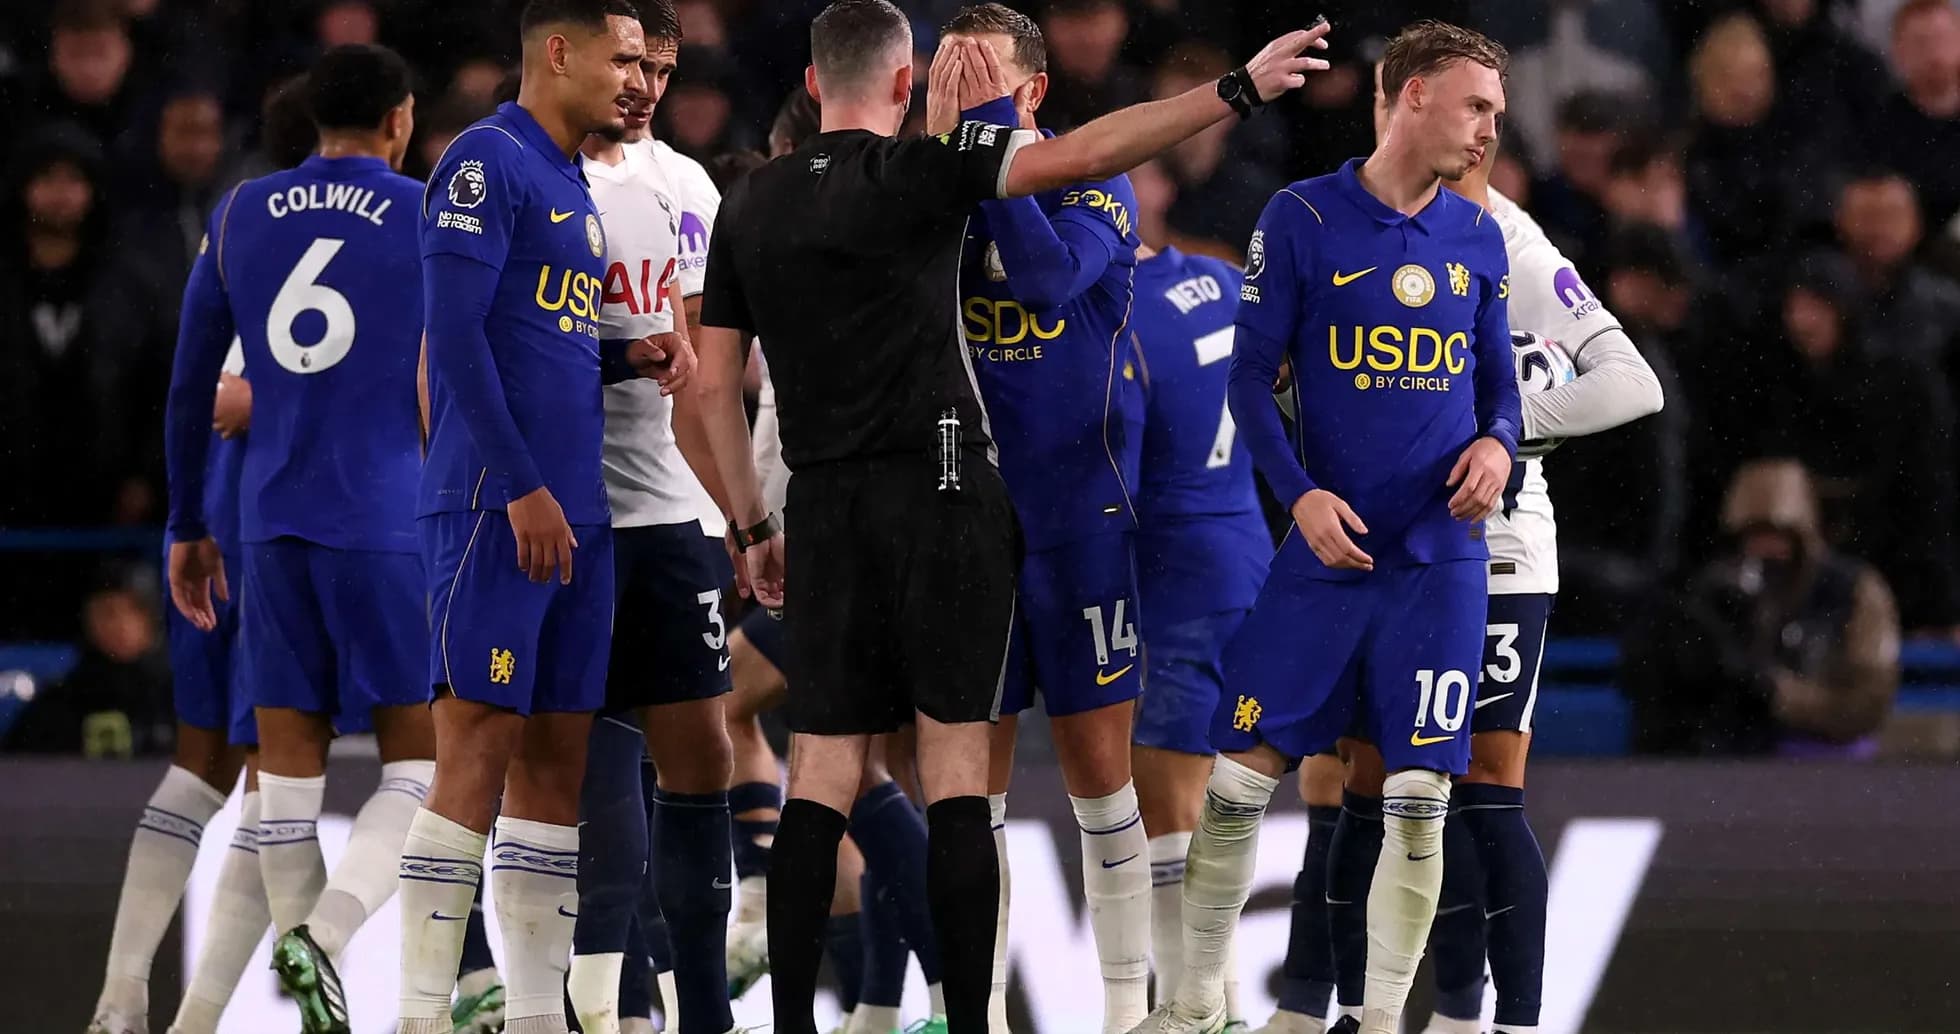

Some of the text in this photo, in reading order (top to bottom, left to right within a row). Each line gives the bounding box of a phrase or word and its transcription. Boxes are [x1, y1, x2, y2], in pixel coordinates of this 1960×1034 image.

[267, 183, 393, 226] COLWILL
[439, 210, 480, 226] No room
[602, 256, 676, 316] AIA
[678, 255, 706, 271] ake
[267, 237, 356, 374] 6
[535, 264, 602, 322] USD
[1164, 275, 1222, 315] NETO
[1572, 300, 1599, 320] kra
[964, 297, 1065, 345] SDC
[987, 345, 1043, 361] CIRCLE
[1329, 325, 1468, 375] USDC
[1193, 323, 1237, 469] 7
[1375, 375, 1450, 392] BY CIRCLE
[697, 588, 723, 650] 3
[1083, 599, 1138, 666] 14
[1478, 623, 1521, 683] 3
[1414, 669, 1470, 732] 10
